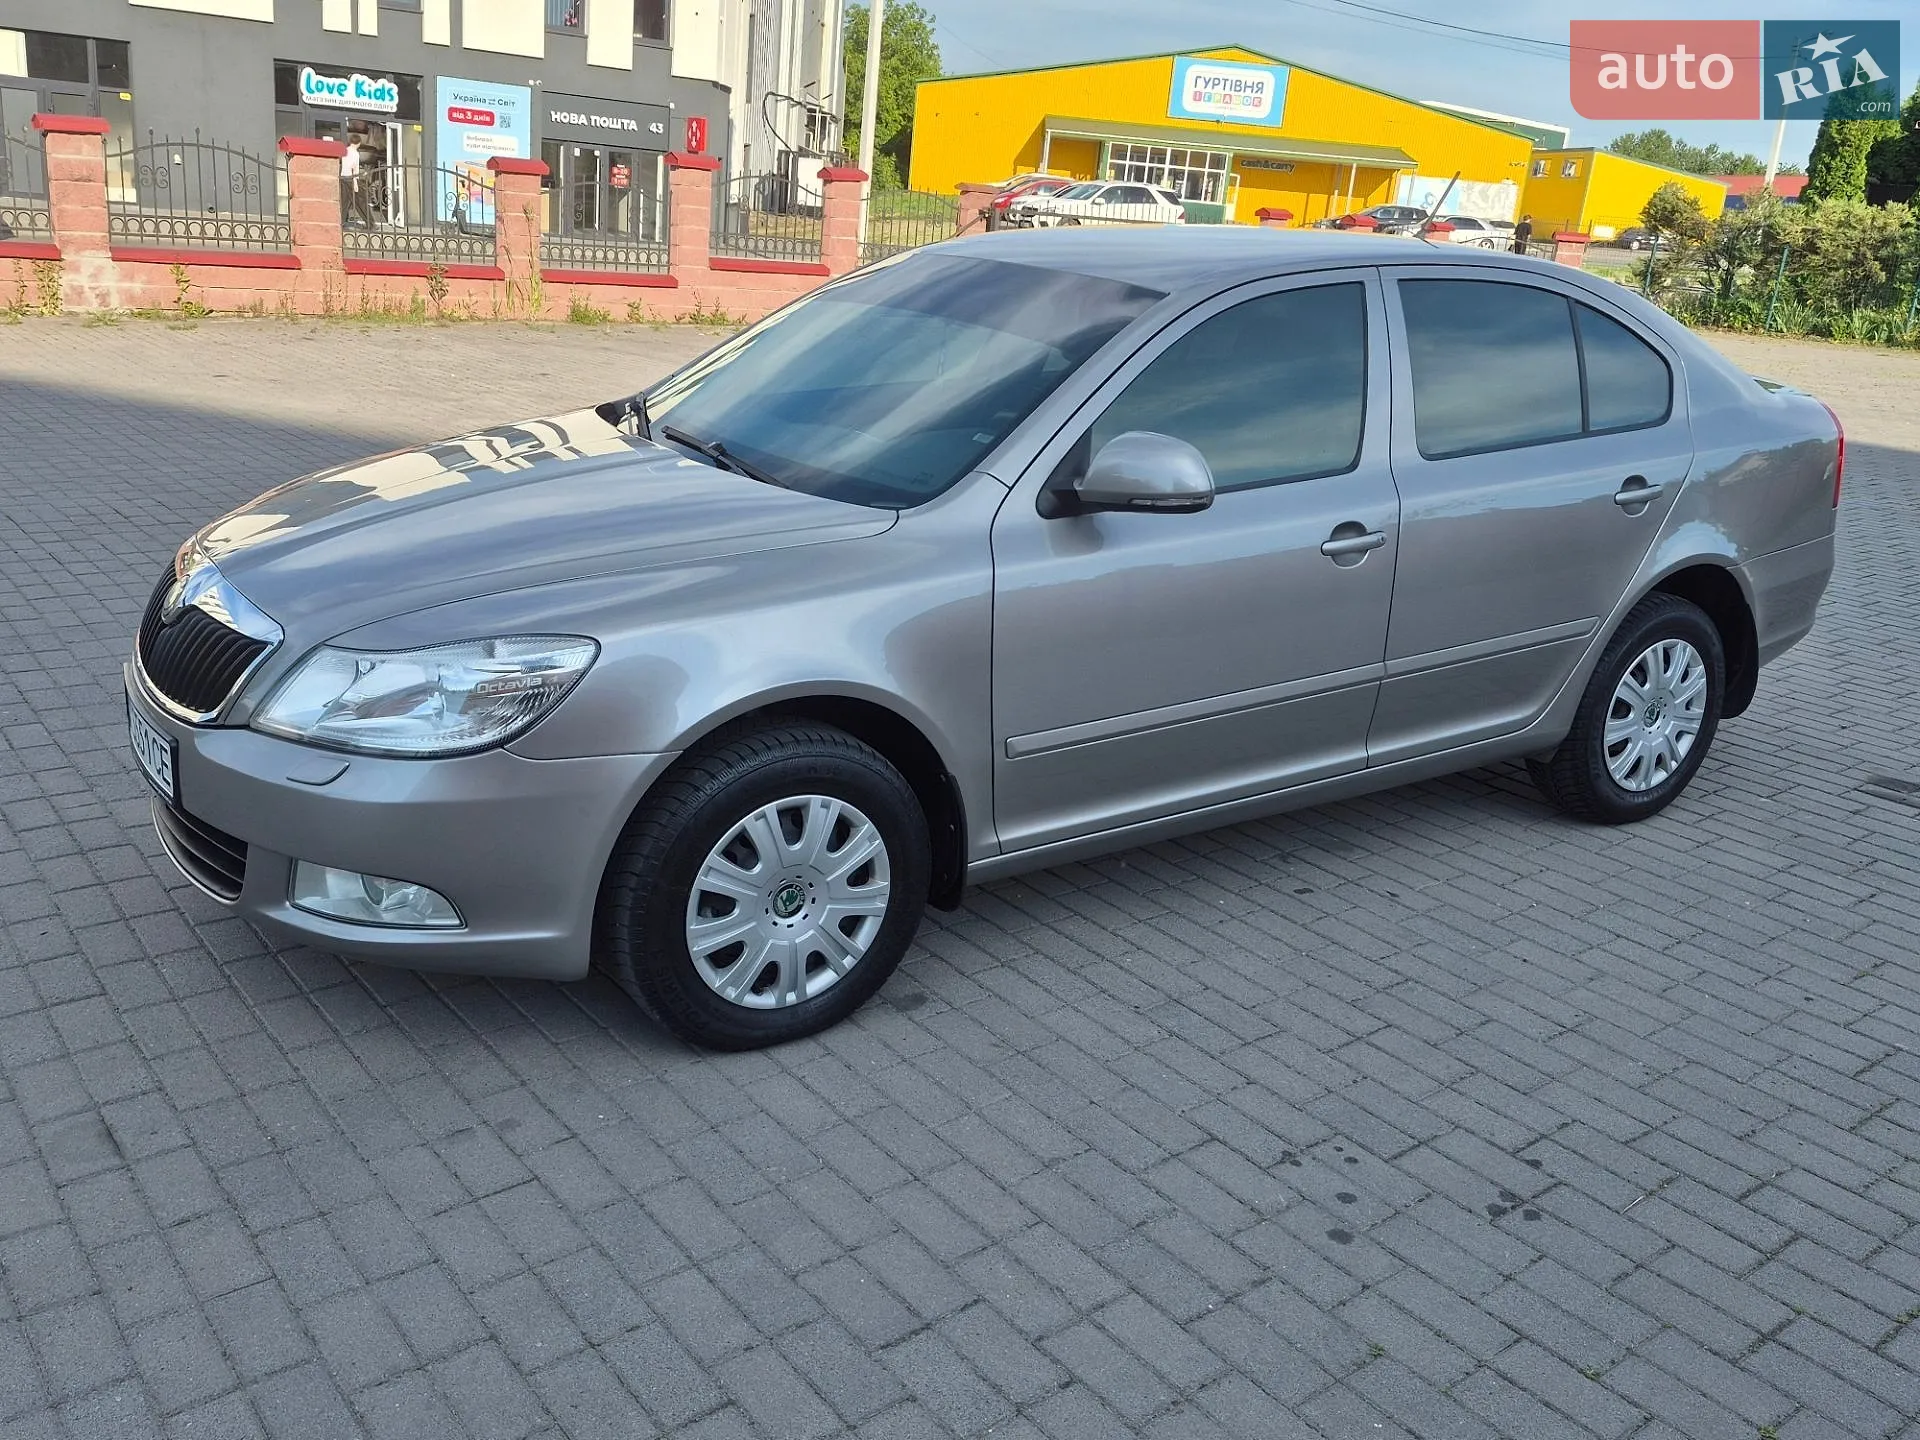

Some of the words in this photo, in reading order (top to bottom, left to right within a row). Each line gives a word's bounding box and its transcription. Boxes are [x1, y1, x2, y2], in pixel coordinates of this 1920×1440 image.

[305, 72, 347, 97] Love
[355, 79, 395, 102] Kids
[1194, 75, 1265, 94] ГУРТІВНЯ
[453, 93, 487, 105] Україна
[498, 99, 516, 107] Світ
[452, 111, 465, 120] від
[466, 111, 472, 120] 3
[473, 113, 491, 122] днів
[550, 110, 588, 127] НОВА
[590, 115, 638, 132] ПОШТА
[649, 122, 664, 134] 43
